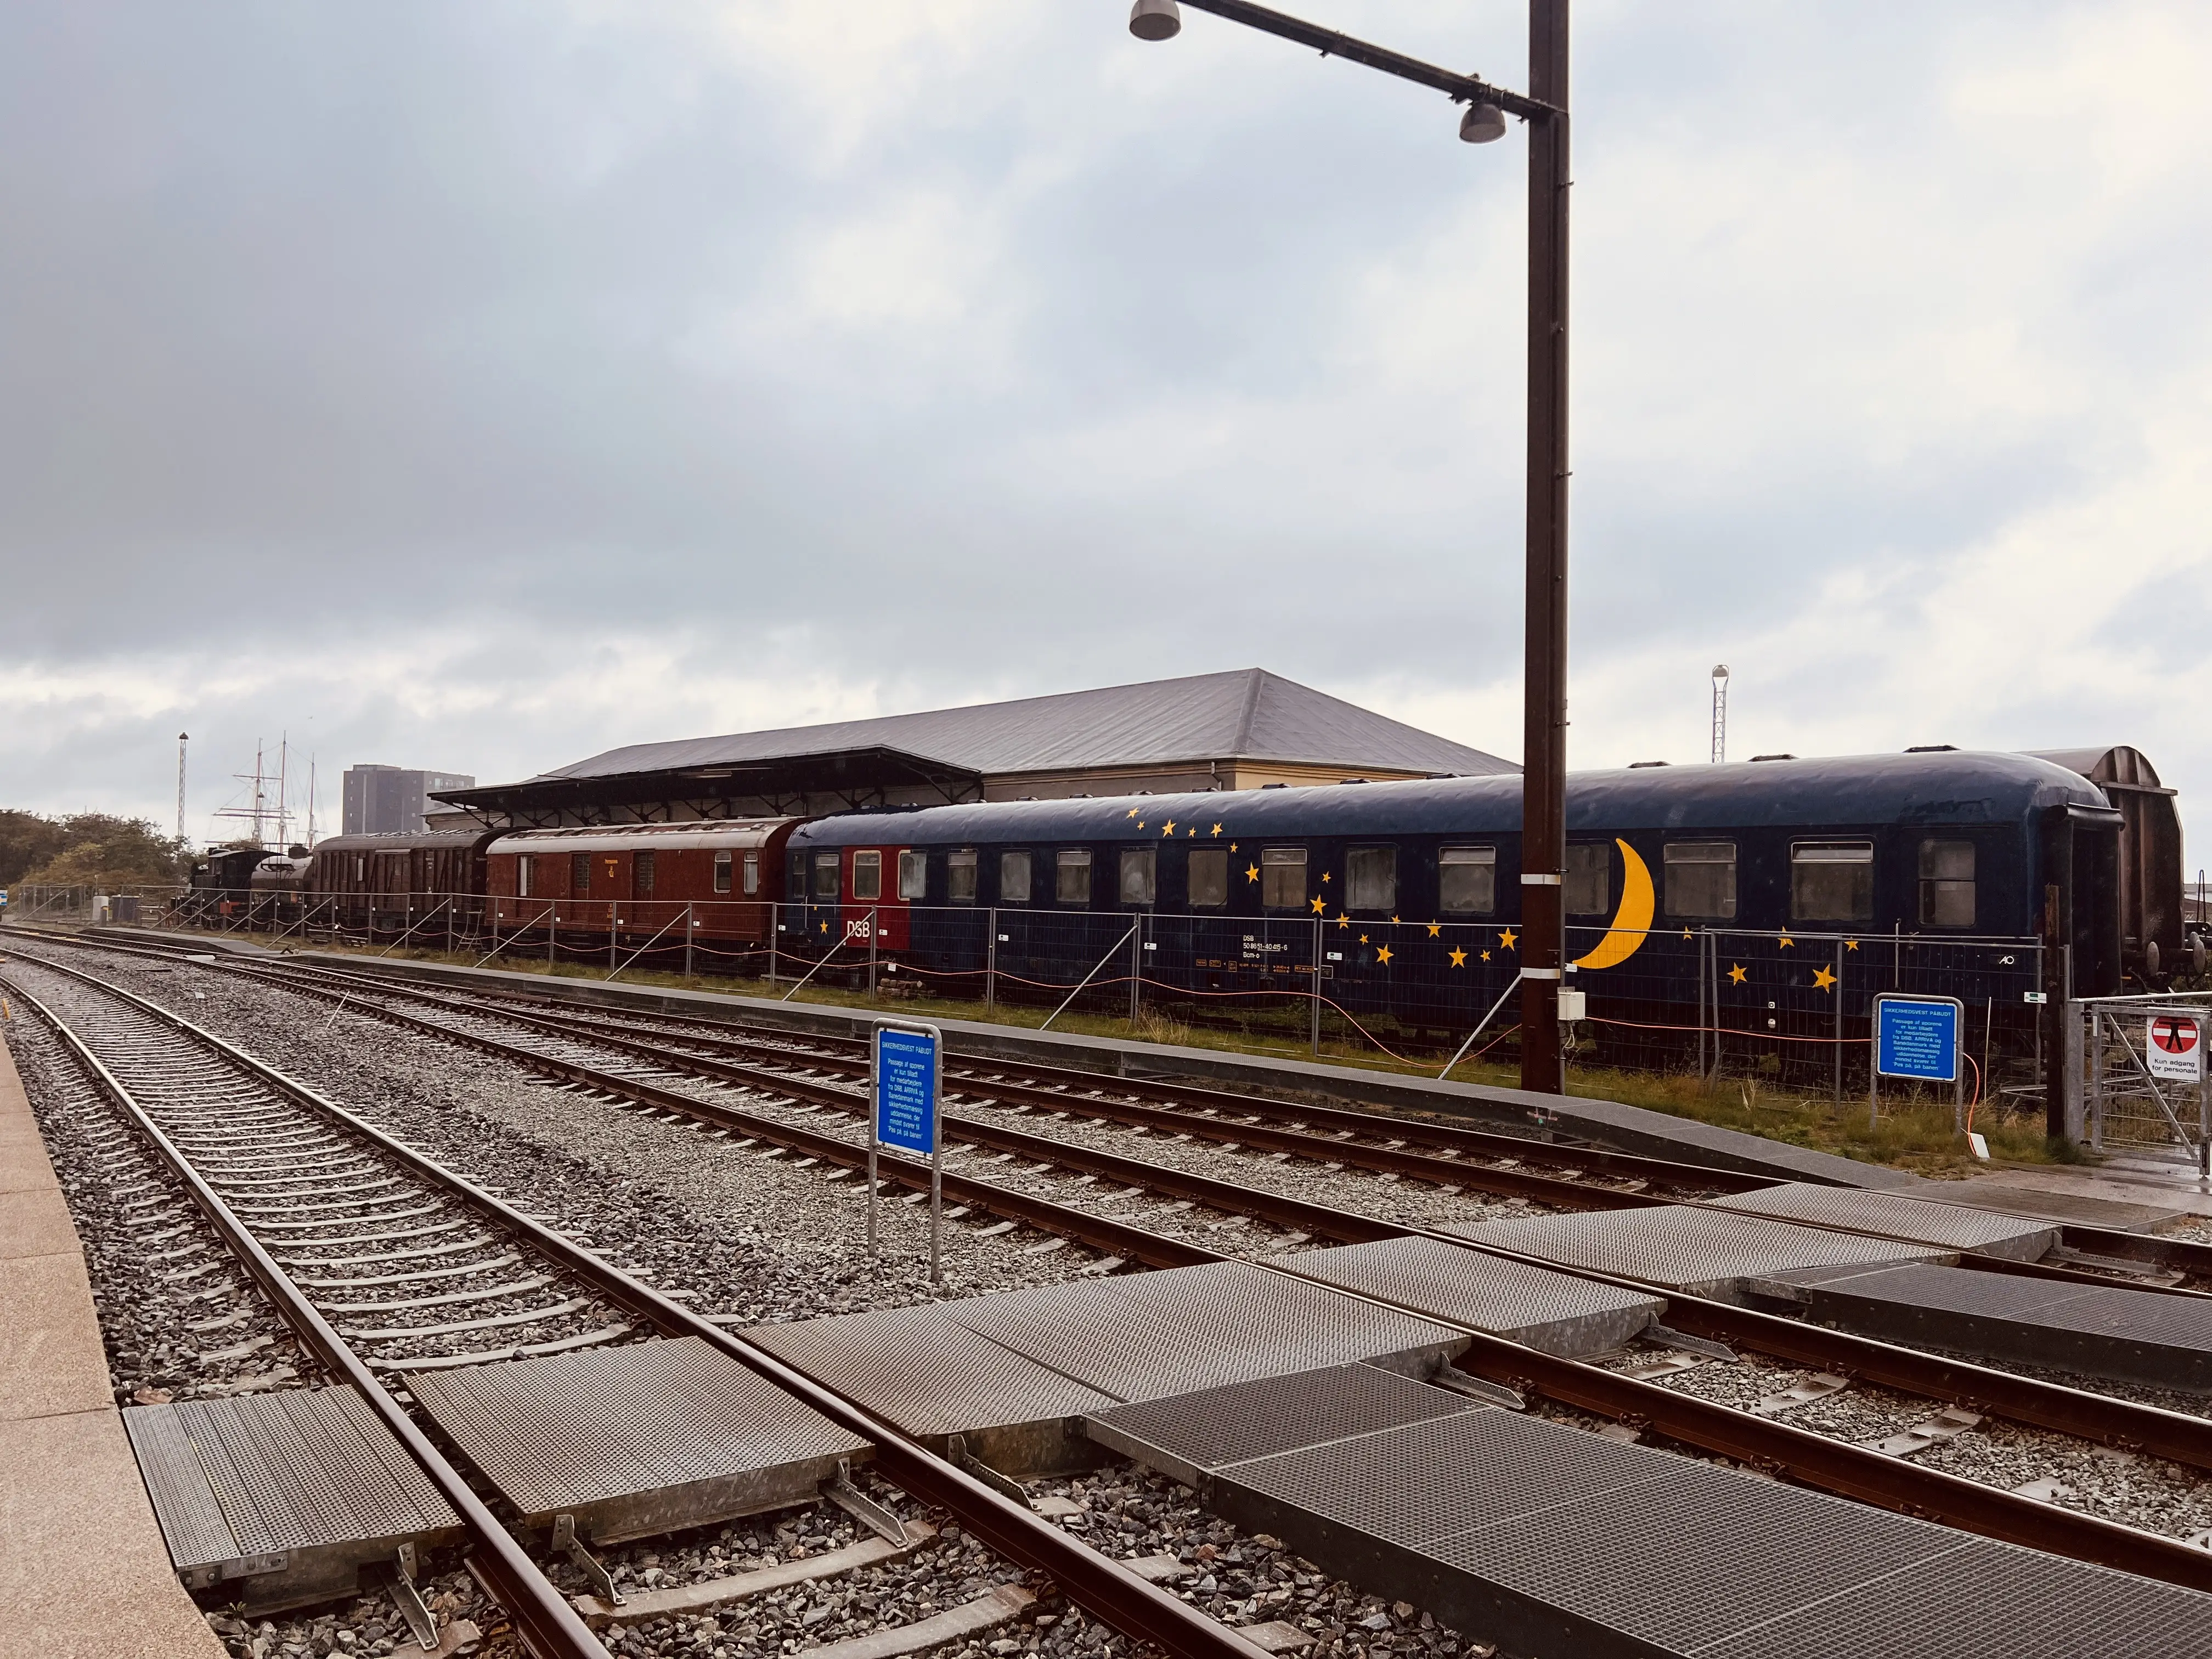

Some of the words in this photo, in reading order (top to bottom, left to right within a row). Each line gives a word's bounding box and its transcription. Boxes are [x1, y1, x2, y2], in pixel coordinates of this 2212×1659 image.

[847, 920, 870, 938] DSB
[882, 1041, 915, 1052] SIKKERHEDSVEST
[915, 1046, 932, 1055] PÅBUDT
[1893, 1046, 1940, 1055] sikkerhedsmæssig
[888, 1058, 904, 1068] Passage
[896, 1077, 922, 1087] medarbejdere
[904, 1086, 918, 1095] ARRIVA
[889, 1091, 914, 1103] Banedanmark
[888, 1101, 923, 1115] sikkerhedsmæssig
[903, 1129, 909, 1137] på
